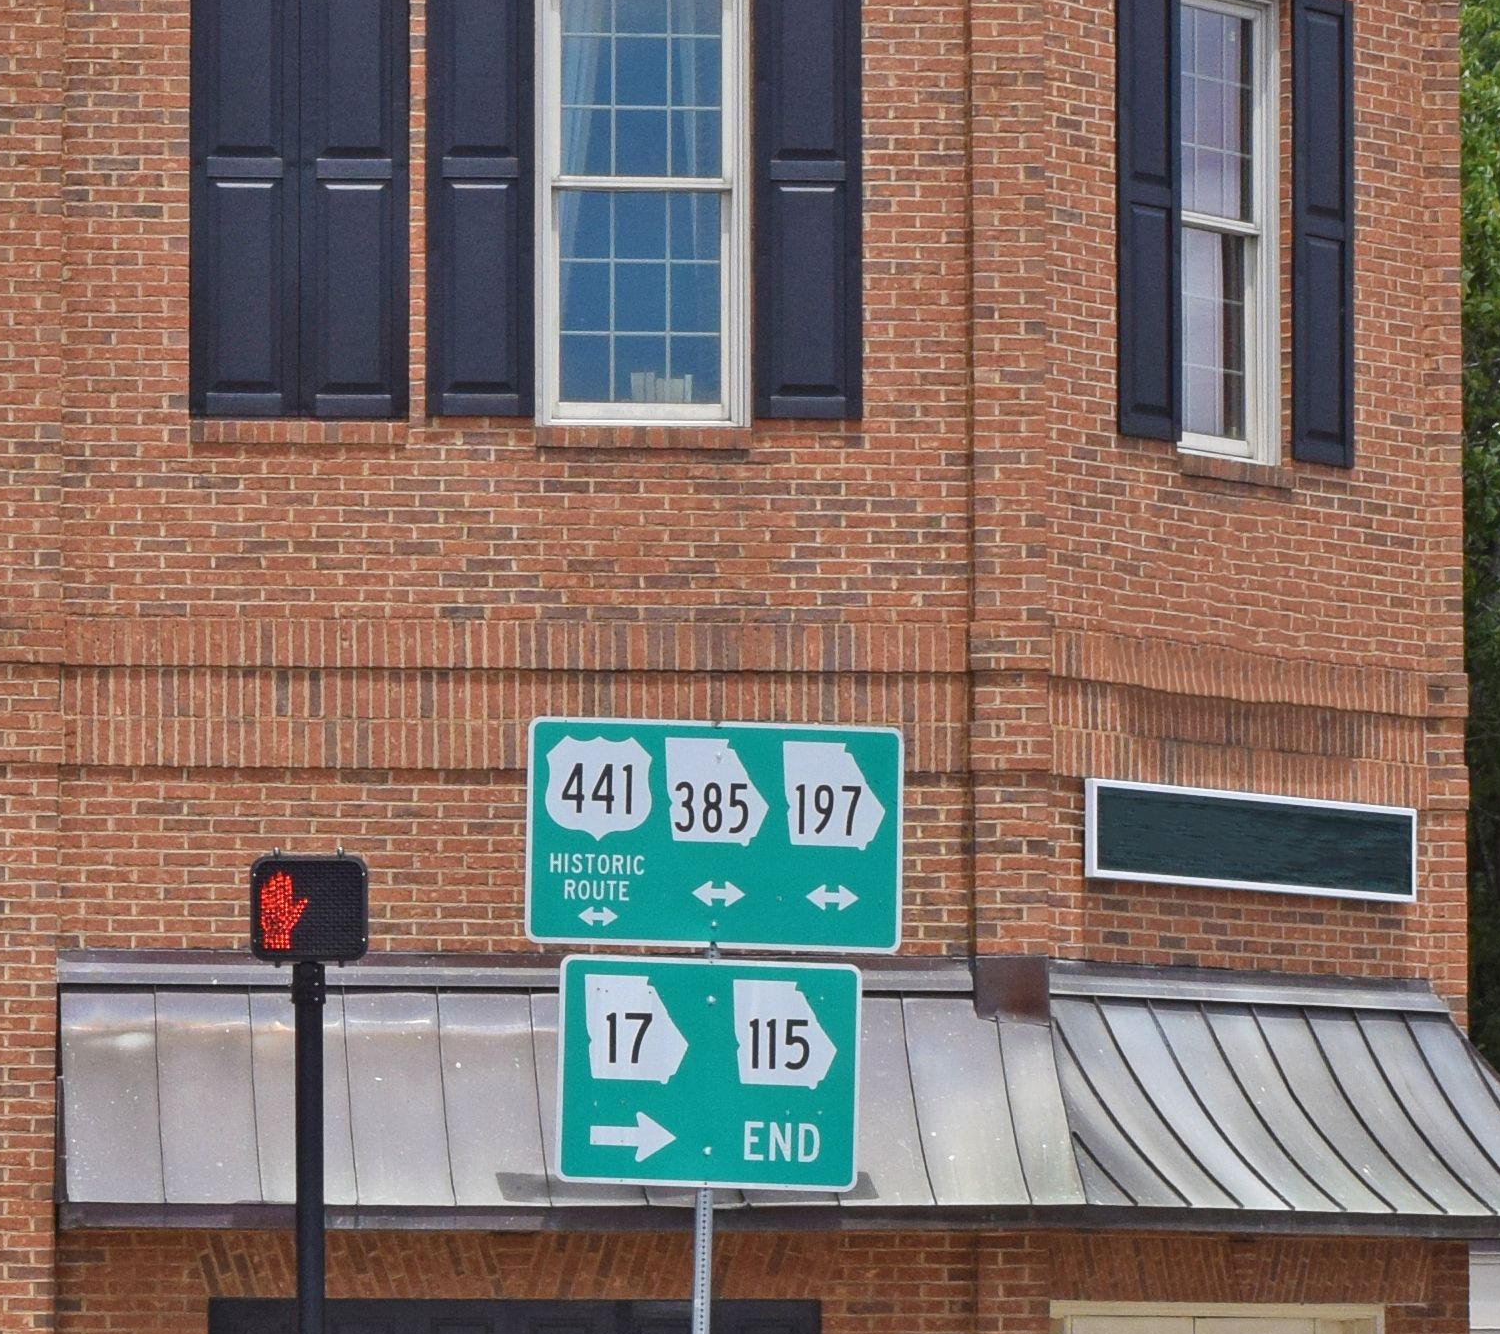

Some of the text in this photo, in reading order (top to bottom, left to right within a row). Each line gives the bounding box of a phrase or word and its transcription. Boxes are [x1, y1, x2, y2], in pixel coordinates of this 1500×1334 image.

[561, 762, 633, 815] 441
[674, 781, 749, 834] 385
[795, 784, 862, 836] 197
[550, 852, 645, 875] HISTORIC
[564, 879, 630, 901] ROUTE
[606, 1012, 653, 1064] 17
[749, 1018, 810, 1071] 115
[743, 1120, 821, 1163] END
